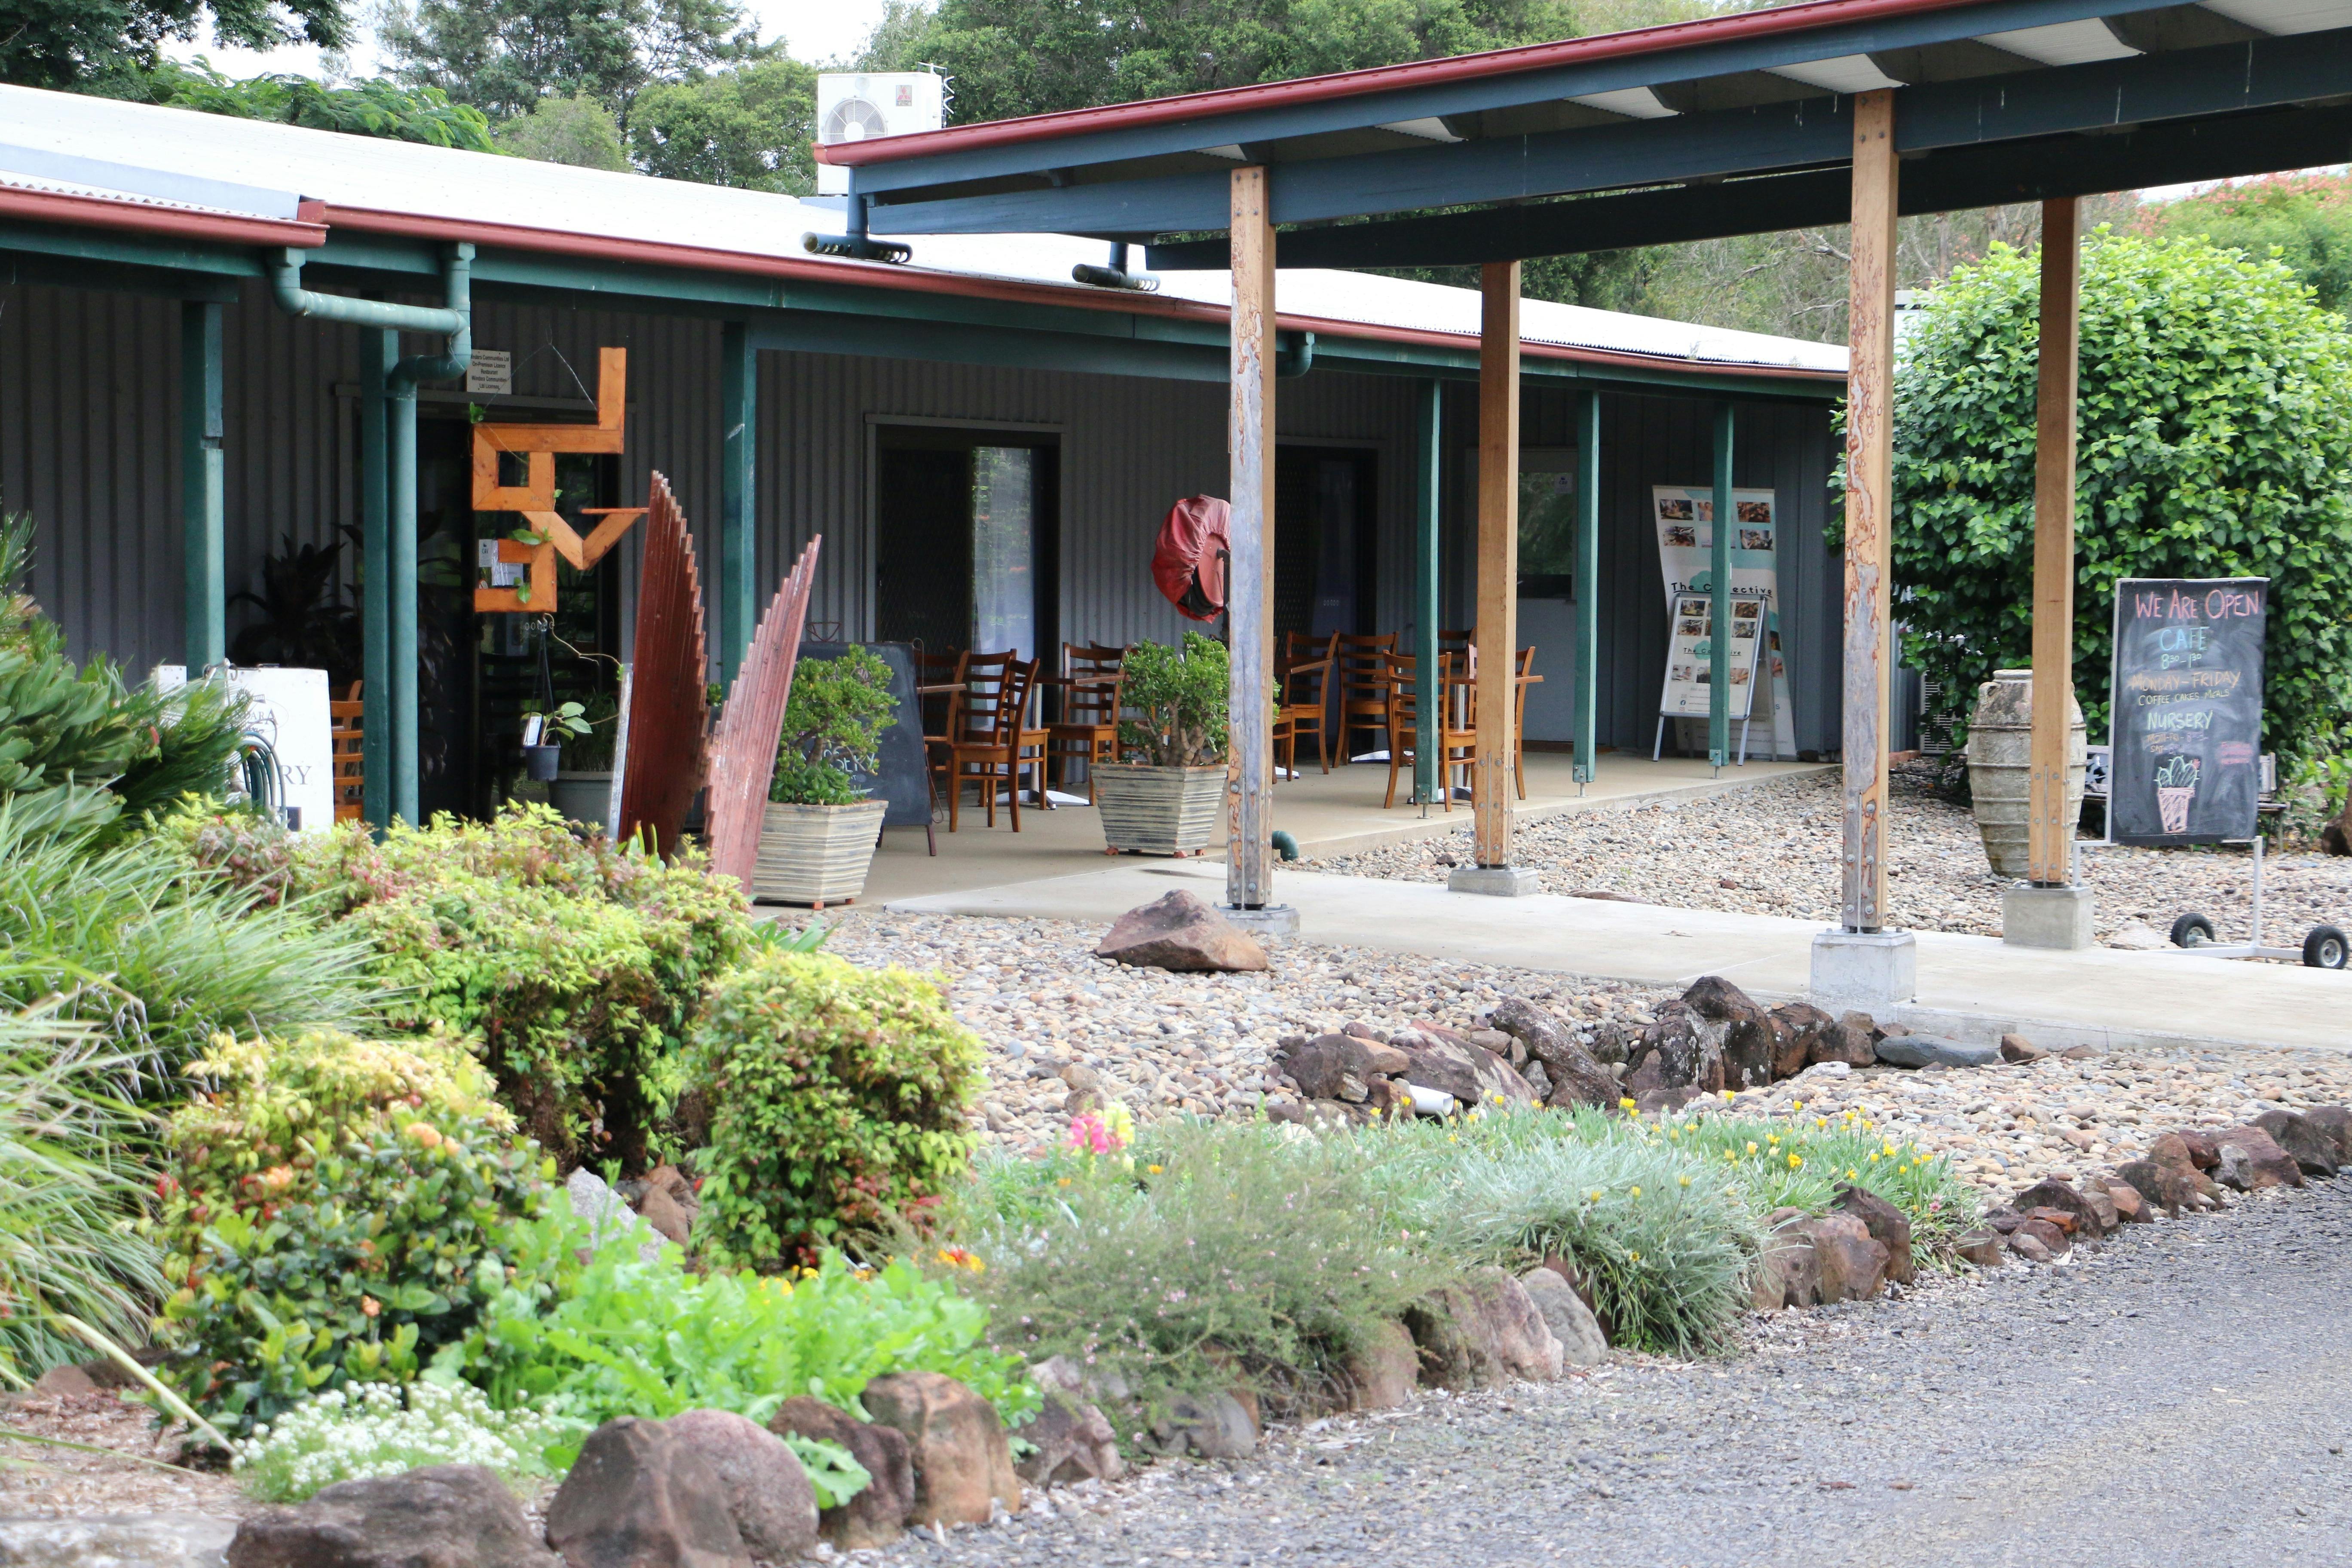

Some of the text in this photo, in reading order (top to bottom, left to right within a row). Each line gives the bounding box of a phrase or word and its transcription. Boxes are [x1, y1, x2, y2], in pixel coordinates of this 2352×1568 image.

[1671, 582, 1772, 595] The Cective
[2135, 589, 2259, 619] WE ARE OPEN
[2160, 626, 2210, 651] CAFE
[2147, 710, 2214, 730] NURSERY
